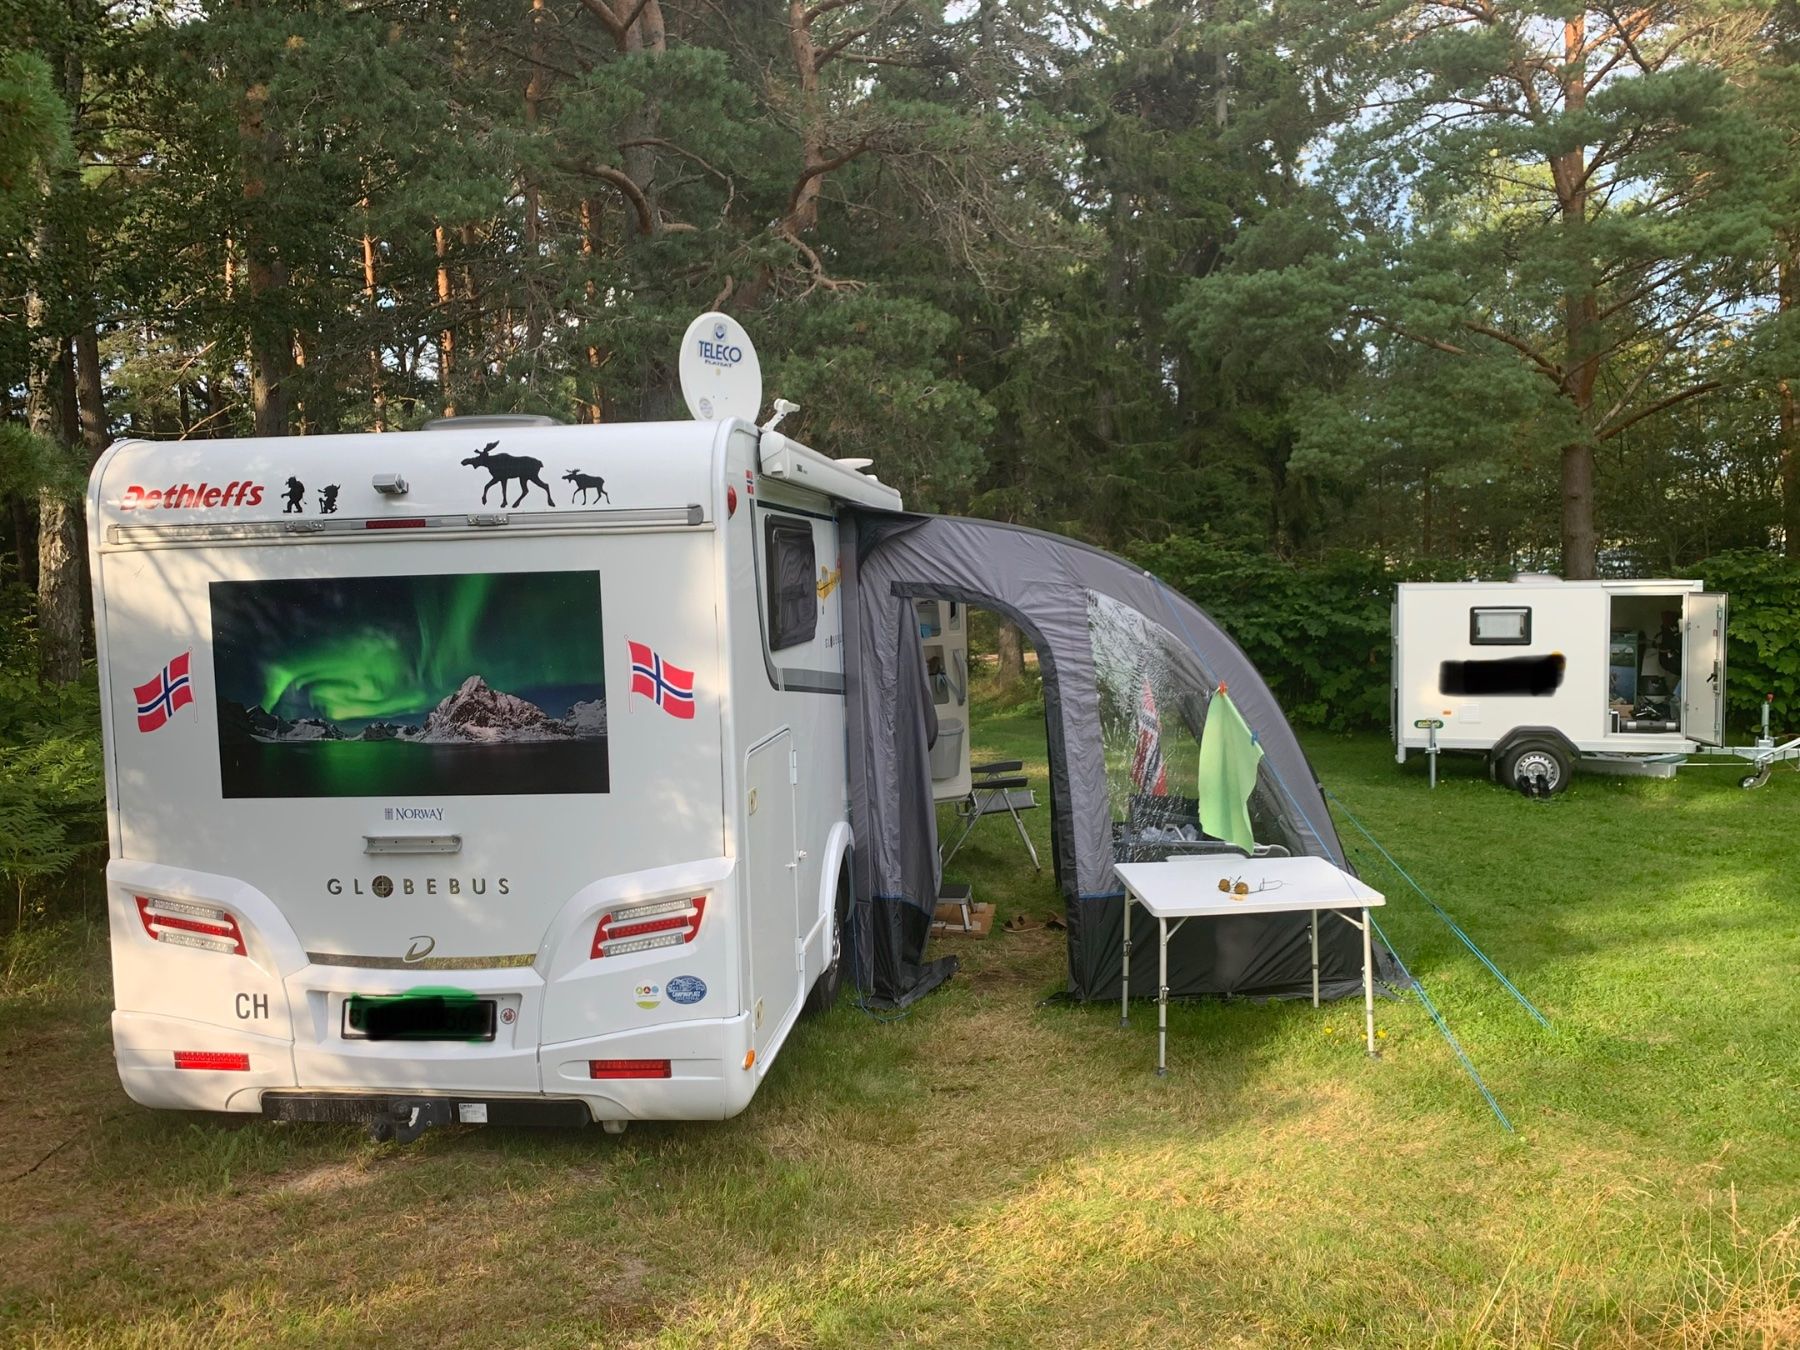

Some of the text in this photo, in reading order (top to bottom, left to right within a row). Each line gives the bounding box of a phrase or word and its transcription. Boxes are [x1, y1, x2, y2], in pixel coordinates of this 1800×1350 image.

[698, 340, 742, 363] TELECO
[120, 481, 265, 510] Dethleffs
[395, 808, 444, 821] NORWAY
[327, 876, 509, 898] GLOBEBUS
[235, 993, 268, 1019] CH
